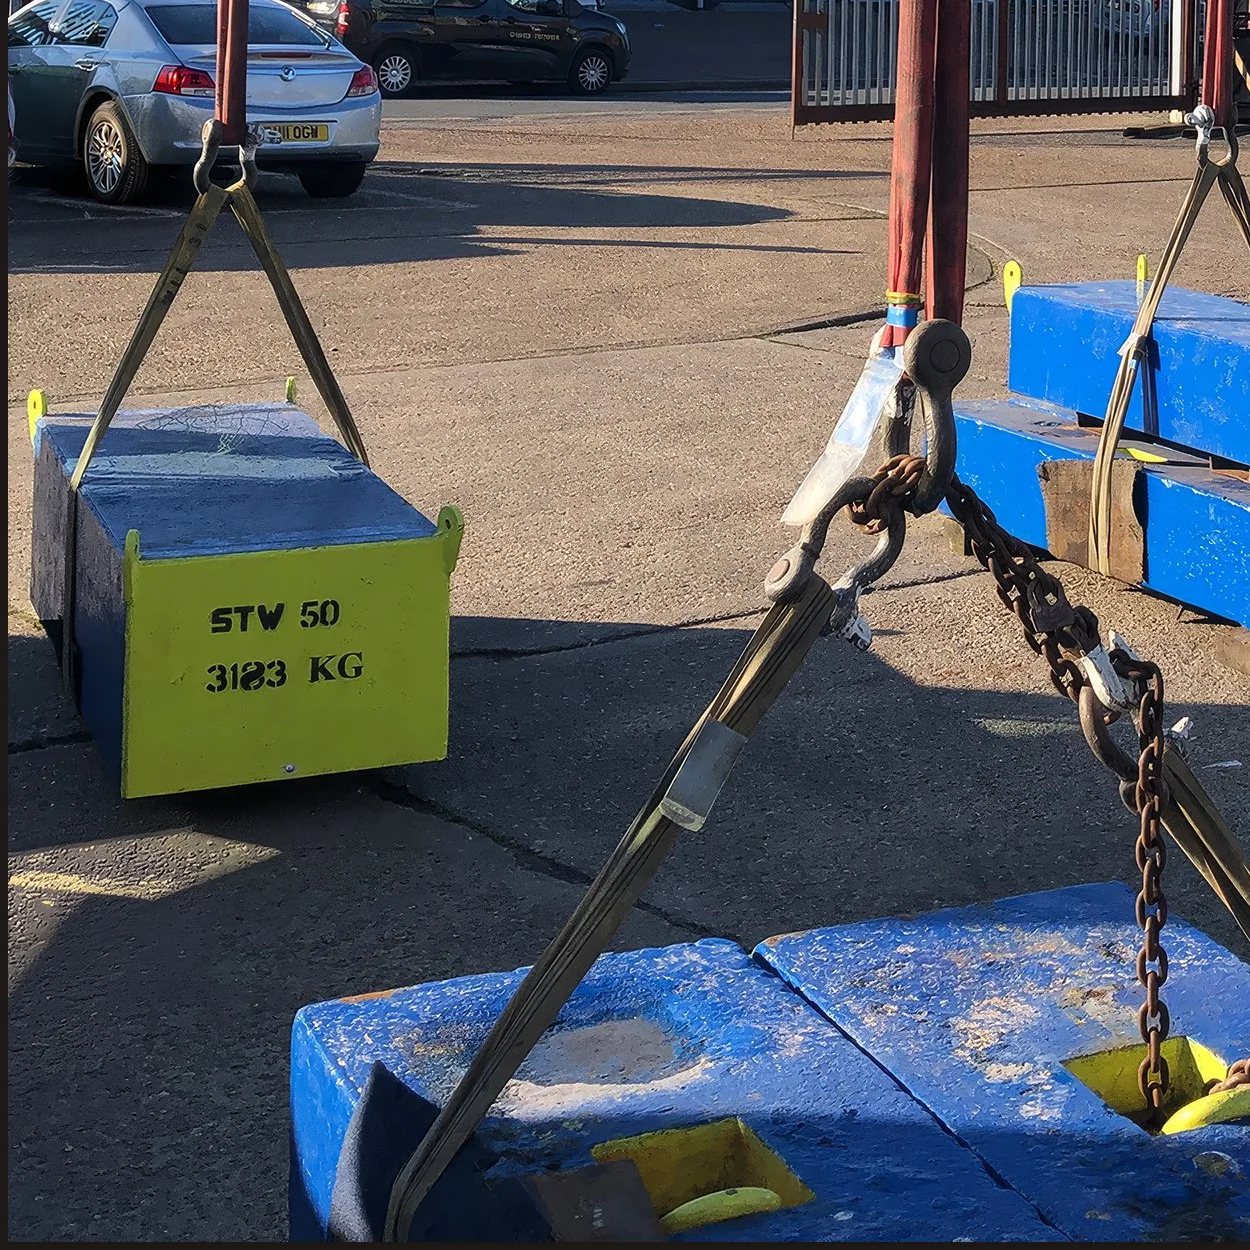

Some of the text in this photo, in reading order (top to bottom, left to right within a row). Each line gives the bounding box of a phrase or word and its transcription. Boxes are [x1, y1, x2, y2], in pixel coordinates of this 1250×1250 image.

[211, 598, 341, 634] STW 50
[308, 651, 365, 685] KG
